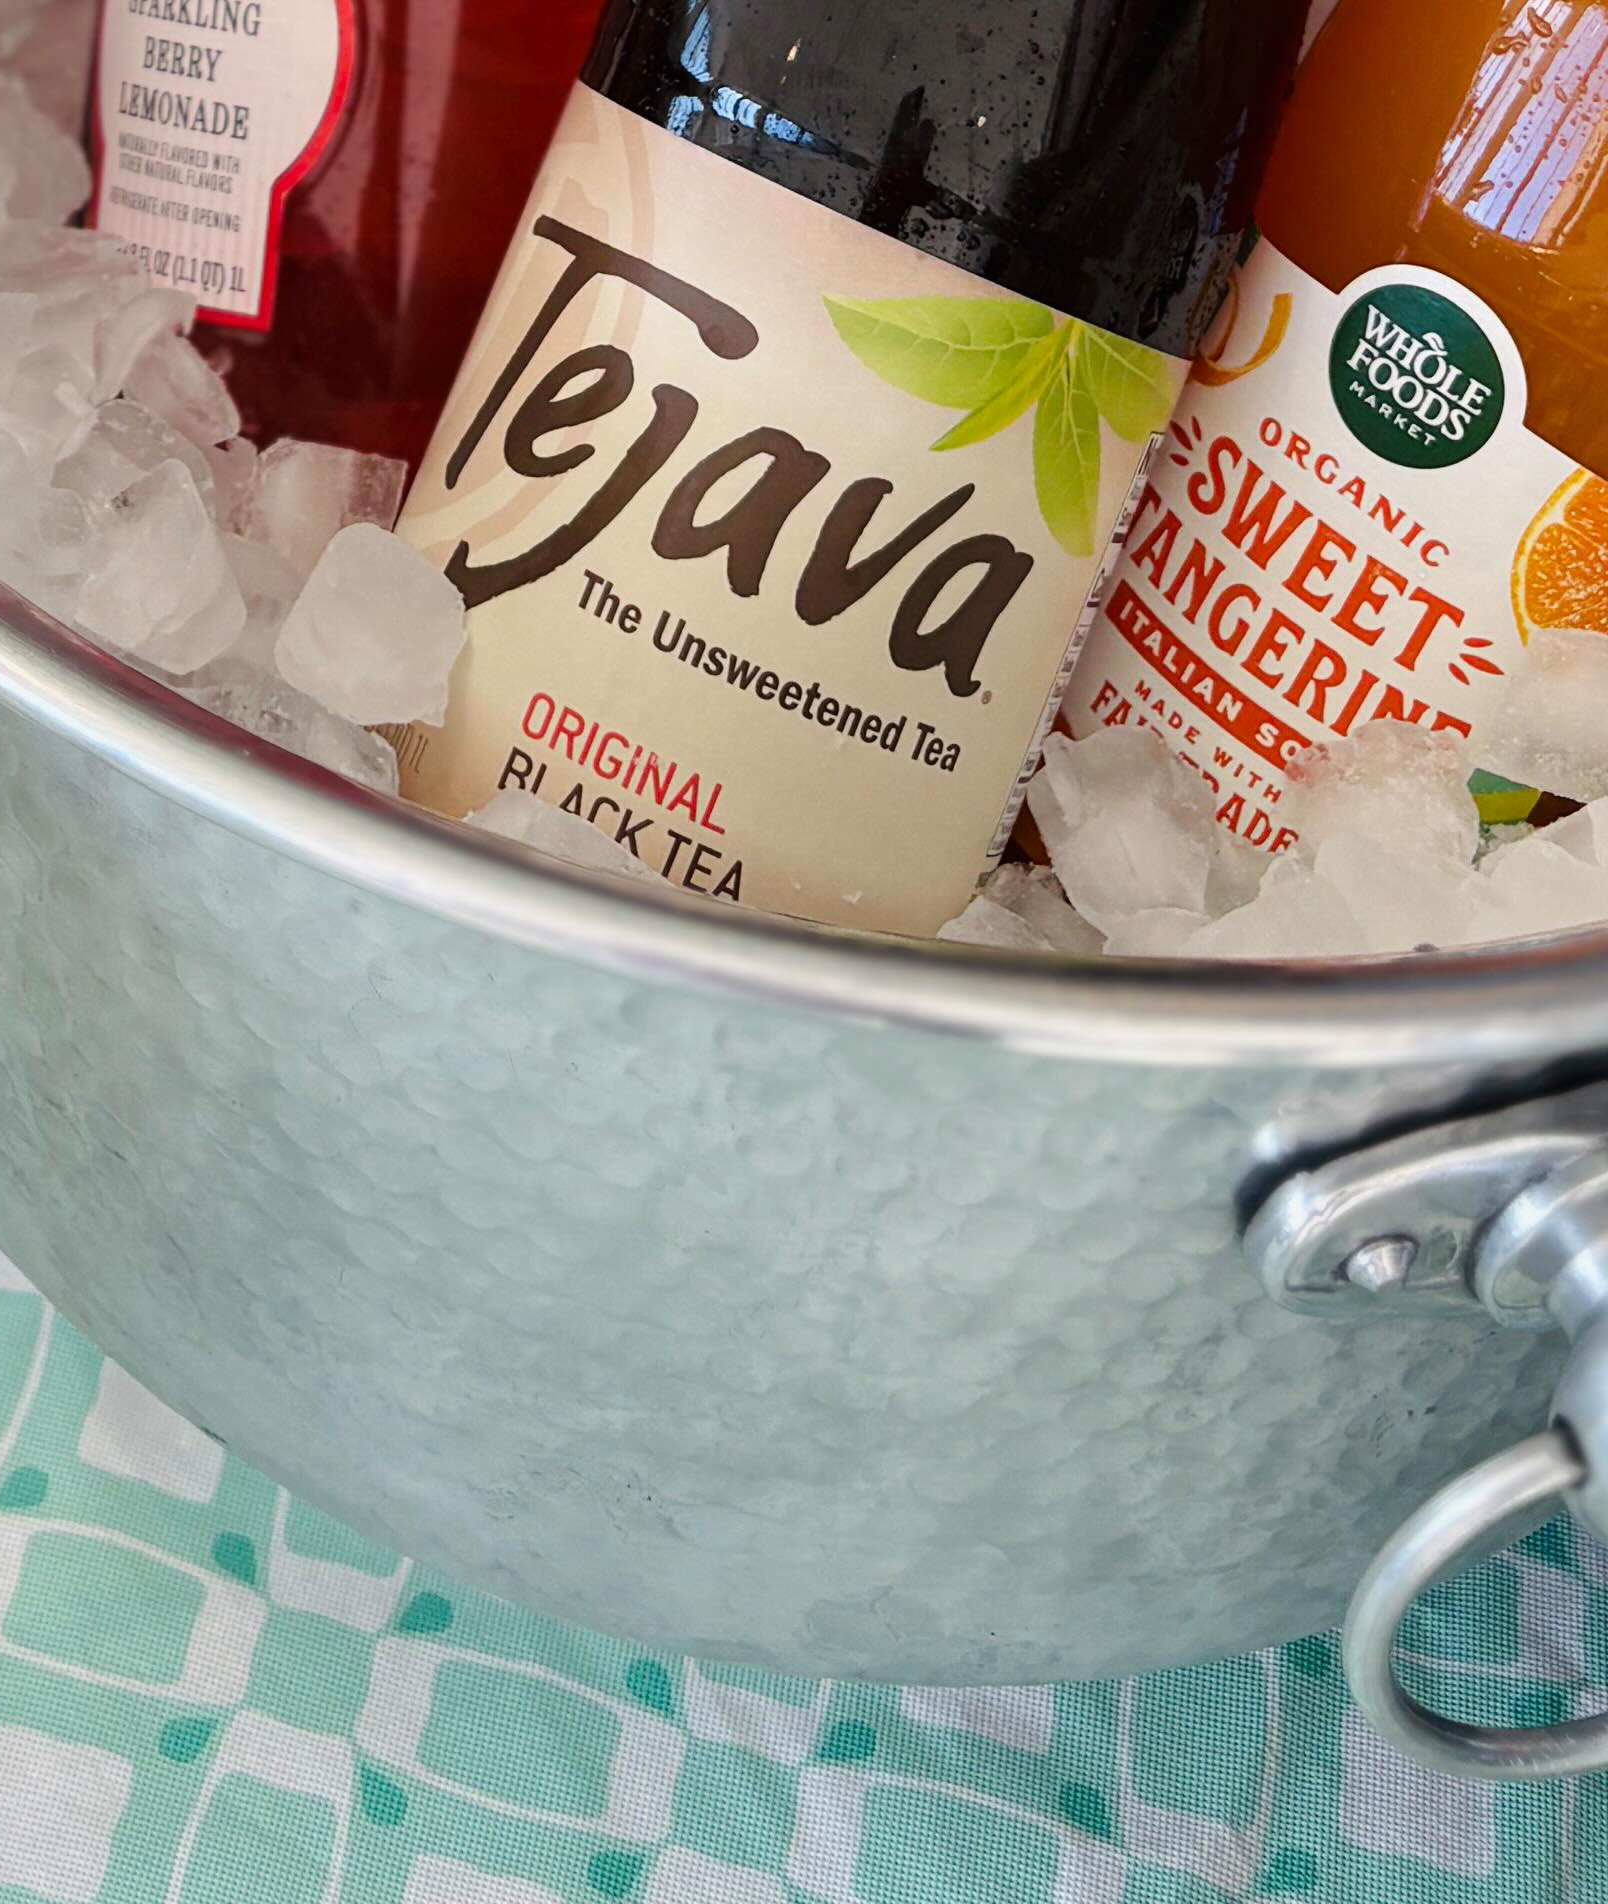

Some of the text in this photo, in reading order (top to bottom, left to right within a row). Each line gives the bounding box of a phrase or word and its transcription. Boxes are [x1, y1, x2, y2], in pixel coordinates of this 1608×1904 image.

[119, 81, 250, 140] LEMONADE
[143, 36, 223, 82] BERRY
[160, 142, 208, 169] FLAVORED
[213, 153, 241, 174] WITH
[186, 169, 234, 194] FLAVORS
[154, 249, 171, 277] OZ
[229, 265, 247, 293] 1L
[193, 207, 240, 233] OPENING
[1346, 338, 1471, 441] FOODS
[1349, 380, 1437, 447] MARKET
[1363, 303, 1492, 416] WHOLE
[445, 214, 1035, 699] Tejava
[1259, 417, 1450, 568] ORGANIC
[1187, 435, 1466, 672] SWEET
[577, 569, 643, 634] The
[651, 609, 908, 753] Unsweetened
[911, 721, 962, 773] Tea
[1119, 600, 1243, 722] ITALIAN
[522, 692, 726, 835] ORIGINAL
[1090, 680, 1166, 739] FA
[1177, 750, 1300, 854] ADE
[1133, 680, 1282, 804] MADE WITH
[661, 829, 743, 902] TEA
